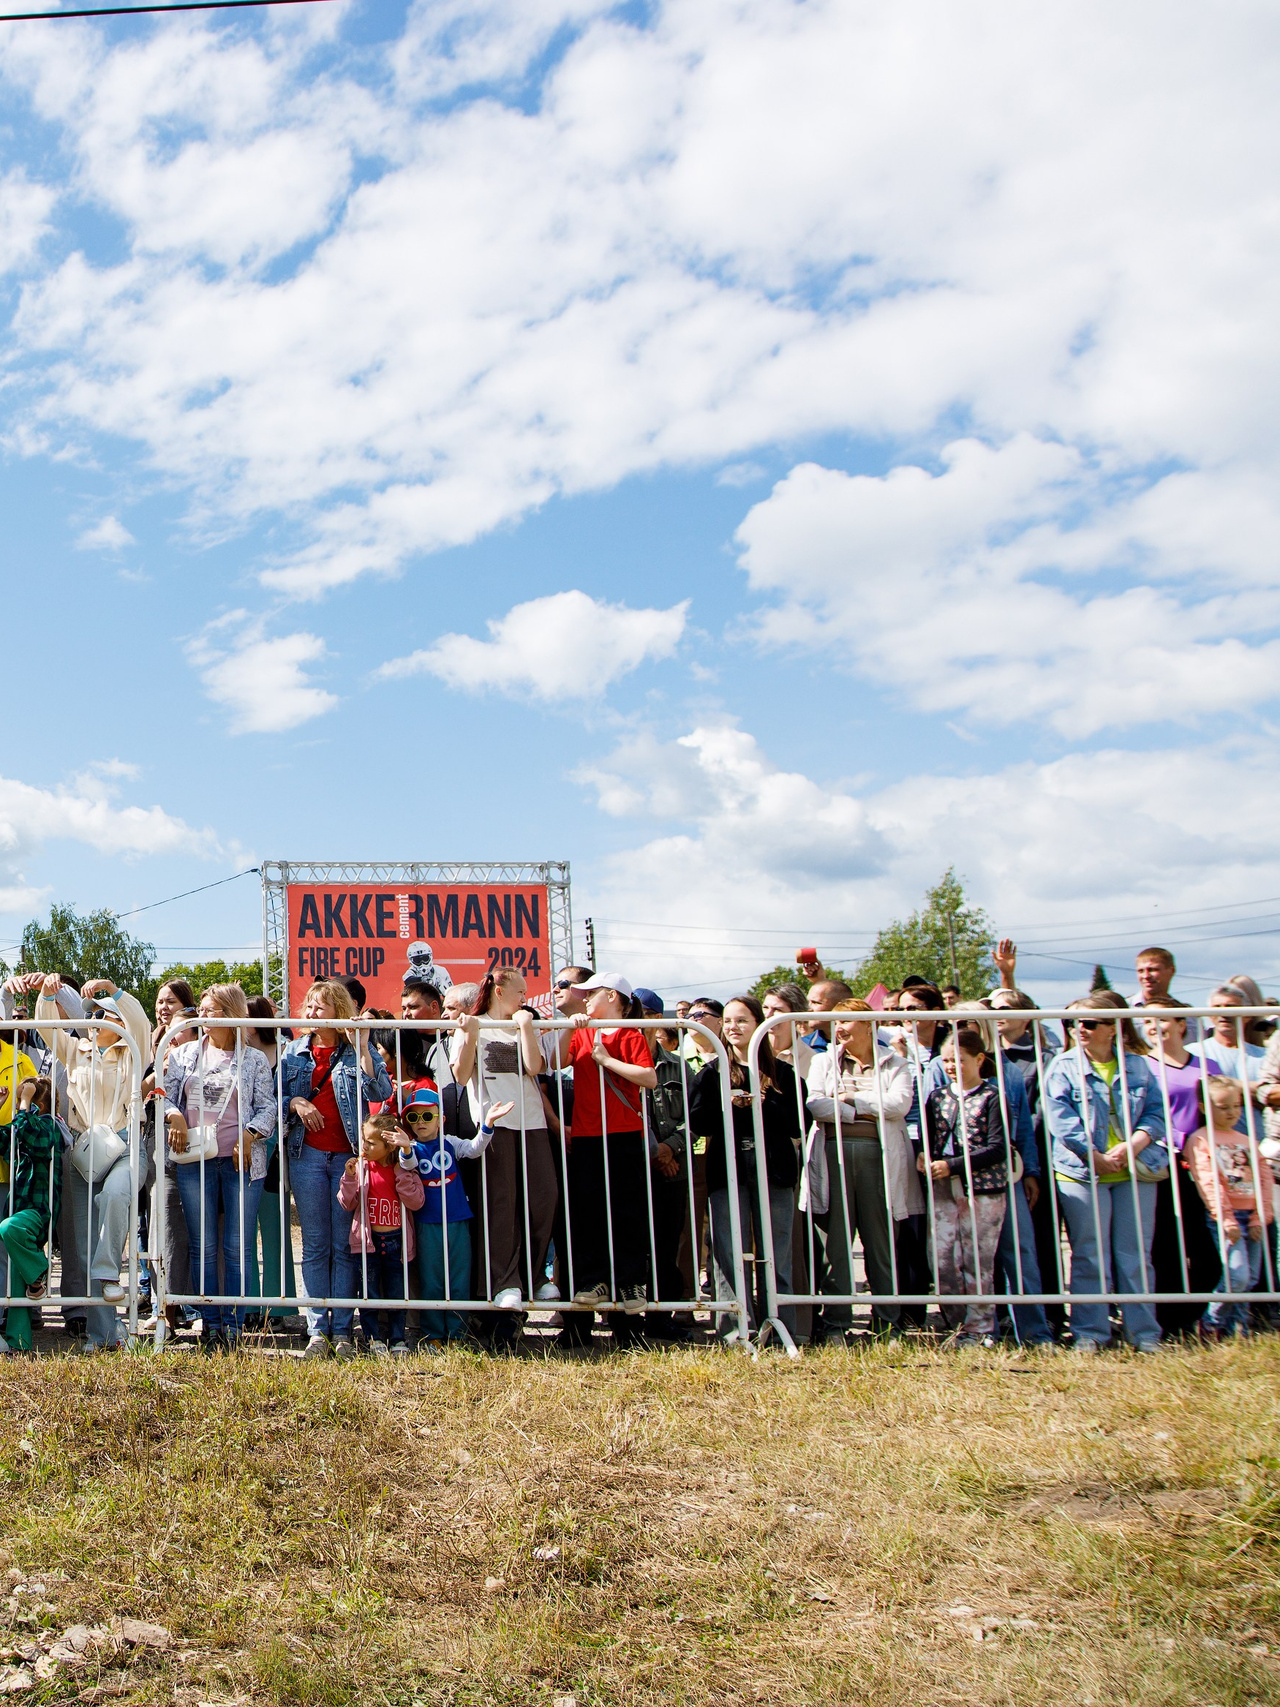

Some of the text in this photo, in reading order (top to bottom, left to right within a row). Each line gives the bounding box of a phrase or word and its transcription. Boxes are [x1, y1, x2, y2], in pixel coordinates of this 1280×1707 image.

[298, 894, 540, 938] AKKERMANN
[396, 893, 410, 939] cement
[298, 946, 385, 978] FIRE CUP
[487, 946, 542, 978] 2024
